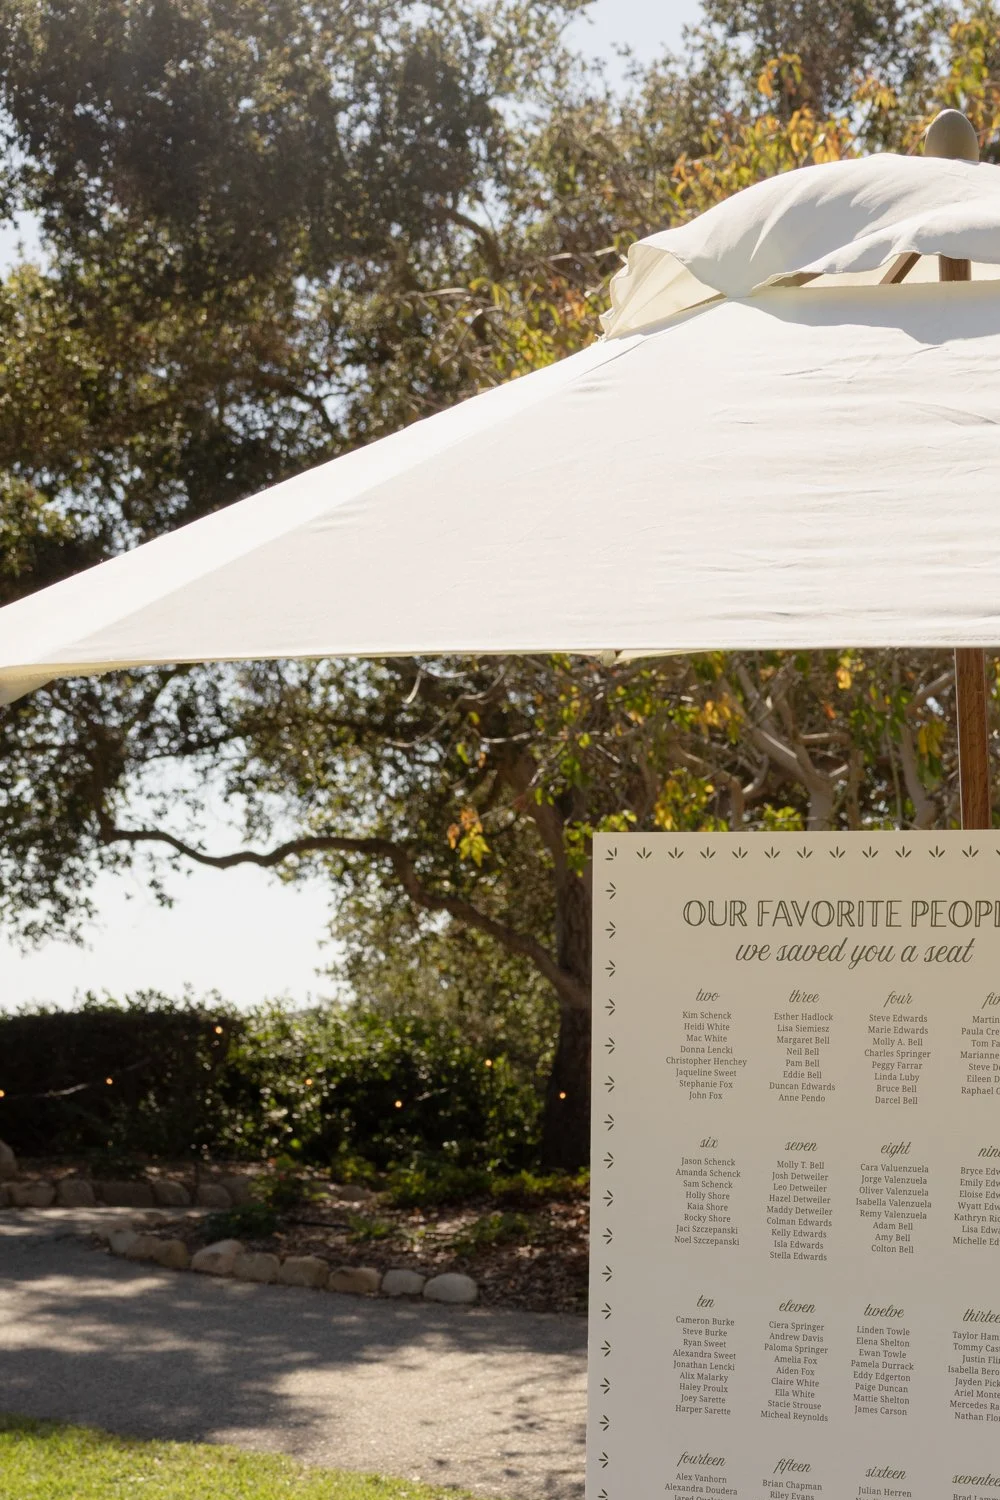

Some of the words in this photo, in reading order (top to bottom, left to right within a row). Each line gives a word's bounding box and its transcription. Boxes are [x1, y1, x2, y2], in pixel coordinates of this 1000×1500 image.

[683, 900, 748, 926] OUR
[757, 900, 902, 927] FAVORITE
[736, 944, 771, 961] we
[776, 937, 848, 961] saved
[848, 945, 895, 970] you
[901, 945, 918, 962] a
[924, 938, 975, 963] seat
[695, 988, 720, 1002] two
[789, 989, 820, 1003] three
[883, 990, 913, 1008] four
[682, 1011, 698, 1019] Kim
[774, 1012, 799, 1021] Esther
[801, 1013, 833, 1021] Hadlock
[869, 1014, 891, 1022] Steve
[893, 1014, 928, 1022] Edwards
[972, 1016, 1000, 1024] Martin
[684, 1022, 705, 1030] Heidi
[706, 1023, 730, 1031] White
[686, 1034, 702, 1042] Mac
[704, 1034, 727, 1042] White
[777, 1035, 813, 1046] Margaret
[815, 1036, 830, 1044] Bell
[873, 1037, 895, 1047] Molly
[897, 1038, 905, 1046] A.
[908, 1038, 923, 1046] Bell
[971, 1039, 989, 1047] Tom
[804, 1048, 819, 1056] Bell
[864, 1048, 894, 1057] Charles
[896, 1049, 931, 1060] Springer
[783, 1070, 805, 1078] Eddie
[807, 1071, 822, 1079] Bell
[967, 1074, 992, 1083] Eileen
[679, 1079, 717, 1089] Stephanie
[719, 1080, 735, 1088] Fox
[876, 1084, 900, 1092] Bruce
[902, 1085, 917, 1093] Bell
[699, 1136, 718, 1149] six
[784, 1141, 818, 1152] seven
[880, 1141, 912, 1158] eight
[681, 1157, 702, 1166] Jason
[777, 1160, 799, 1170] Molly
[800, 1161, 807, 1169] T.
[810, 1161, 824, 1169] Bell
[960, 1166, 983, 1177] Bryce
[861, 1175, 882, 1185] Jorge
[884, 1175, 927, 1185] Valenzuela
[960, 1178, 983, 1189] Emily
[773, 1183, 787, 1191] Leo
[789, 1184, 827, 1193] Detweiler
[686, 1191, 706, 1201] Holly
[708, 1191, 730, 1200] Shore
[856, 1198, 886, 1206] Isabella
[889, 1199, 932, 1208] Valenzuela
[684, 1213, 707, 1224] Rocky
[709, 1214, 731, 1223] Shore
[798, 1218, 832, 1227] Edwards
[954, 1213, 987, 1224] Kathryn
[873, 1221, 896, 1230] Adam
[898, 1222, 913, 1231] Bell
[771, 1228, 791, 1238] Kelly
[793, 1229, 828, 1238] Edwards
[953, 1236, 987, 1245] Michelle
[871, 1244, 897, 1253] Colton
[899, 1245, 914, 1254] Bell
[696, 1294, 715, 1309] ten
[779, 1299, 816, 1313] eleven
[863, 1303, 904, 1318] twelve
[682, 1327, 703, 1336] Steve
[705, 1328, 727, 1337] Burke
[856, 1326, 884, 1334] Linden
[769, 1332, 800, 1341] Andrew
[802, 1333, 824, 1342] Davis
[952, 1331, 979, 1341] Taylor
[683, 1338, 702, 1348] Ryan
[704, 1339, 726, 1348] Sweet
[953, 1342, 984, 1354] Tommy
[859, 1348, 881, 1357] Ewan
[673, 1360, 707, 1369] Jonathan
[774, 1355, 801, 1364] Amelia
[803, 1356, 818, 1365] Fox
[771, 1377, 794, 1386] Claire
[796, 1378, 819, 1387] White
[955, 1377, 982, 1387] Jayden
[855, 1382, 876, 1393] Paige
[878, 1383, 908, 1393] Duncan
[768, 1399, 791, 1408] Stacie
[853, 1393, 878, 1403] Mattie
[880, 1395, 909, 1405] Shelton
[955, 1412, 984, 1421] Nathan
[676, 1451, 726, 1467] fourteen
[773, 1458, 812, 1475] fifteen
[676, 1472, 692, 1481] Alex
[865, 1466, 907, 1480] sixteen
[762, 1479, 784, 1488] Brian
[786, 1481, 822, 1491] Chapman
[770, 1491, 789, 1500] Riley
[791, 1492, 814, 1500] Evans
[858, 1486, 881, 1495] Julian
